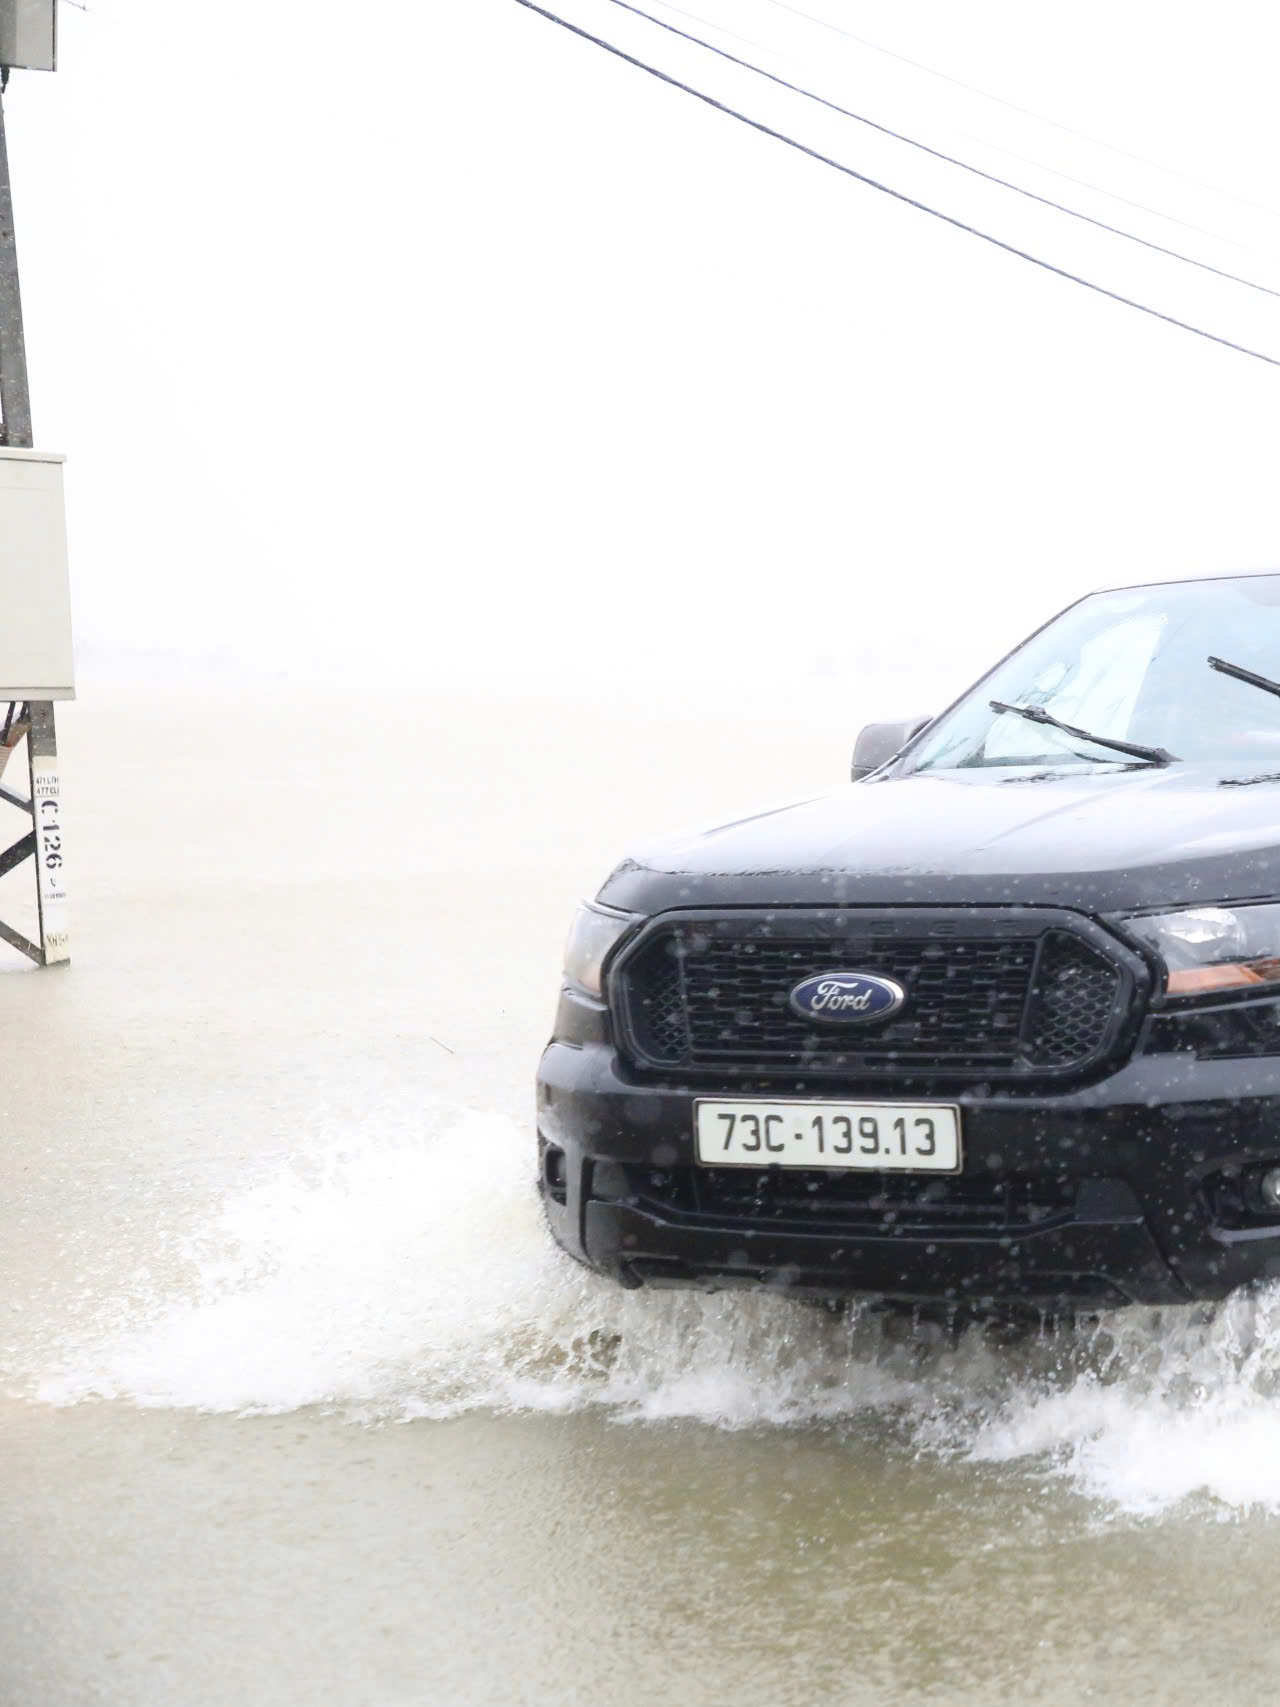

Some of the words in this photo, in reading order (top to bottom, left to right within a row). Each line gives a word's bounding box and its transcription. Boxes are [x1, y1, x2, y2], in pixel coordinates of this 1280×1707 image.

[41, 800, 63, 869] C126
[811, 980, 873, 1010] Ford
[717, 1113, 937, 1156] 73C-139.13
